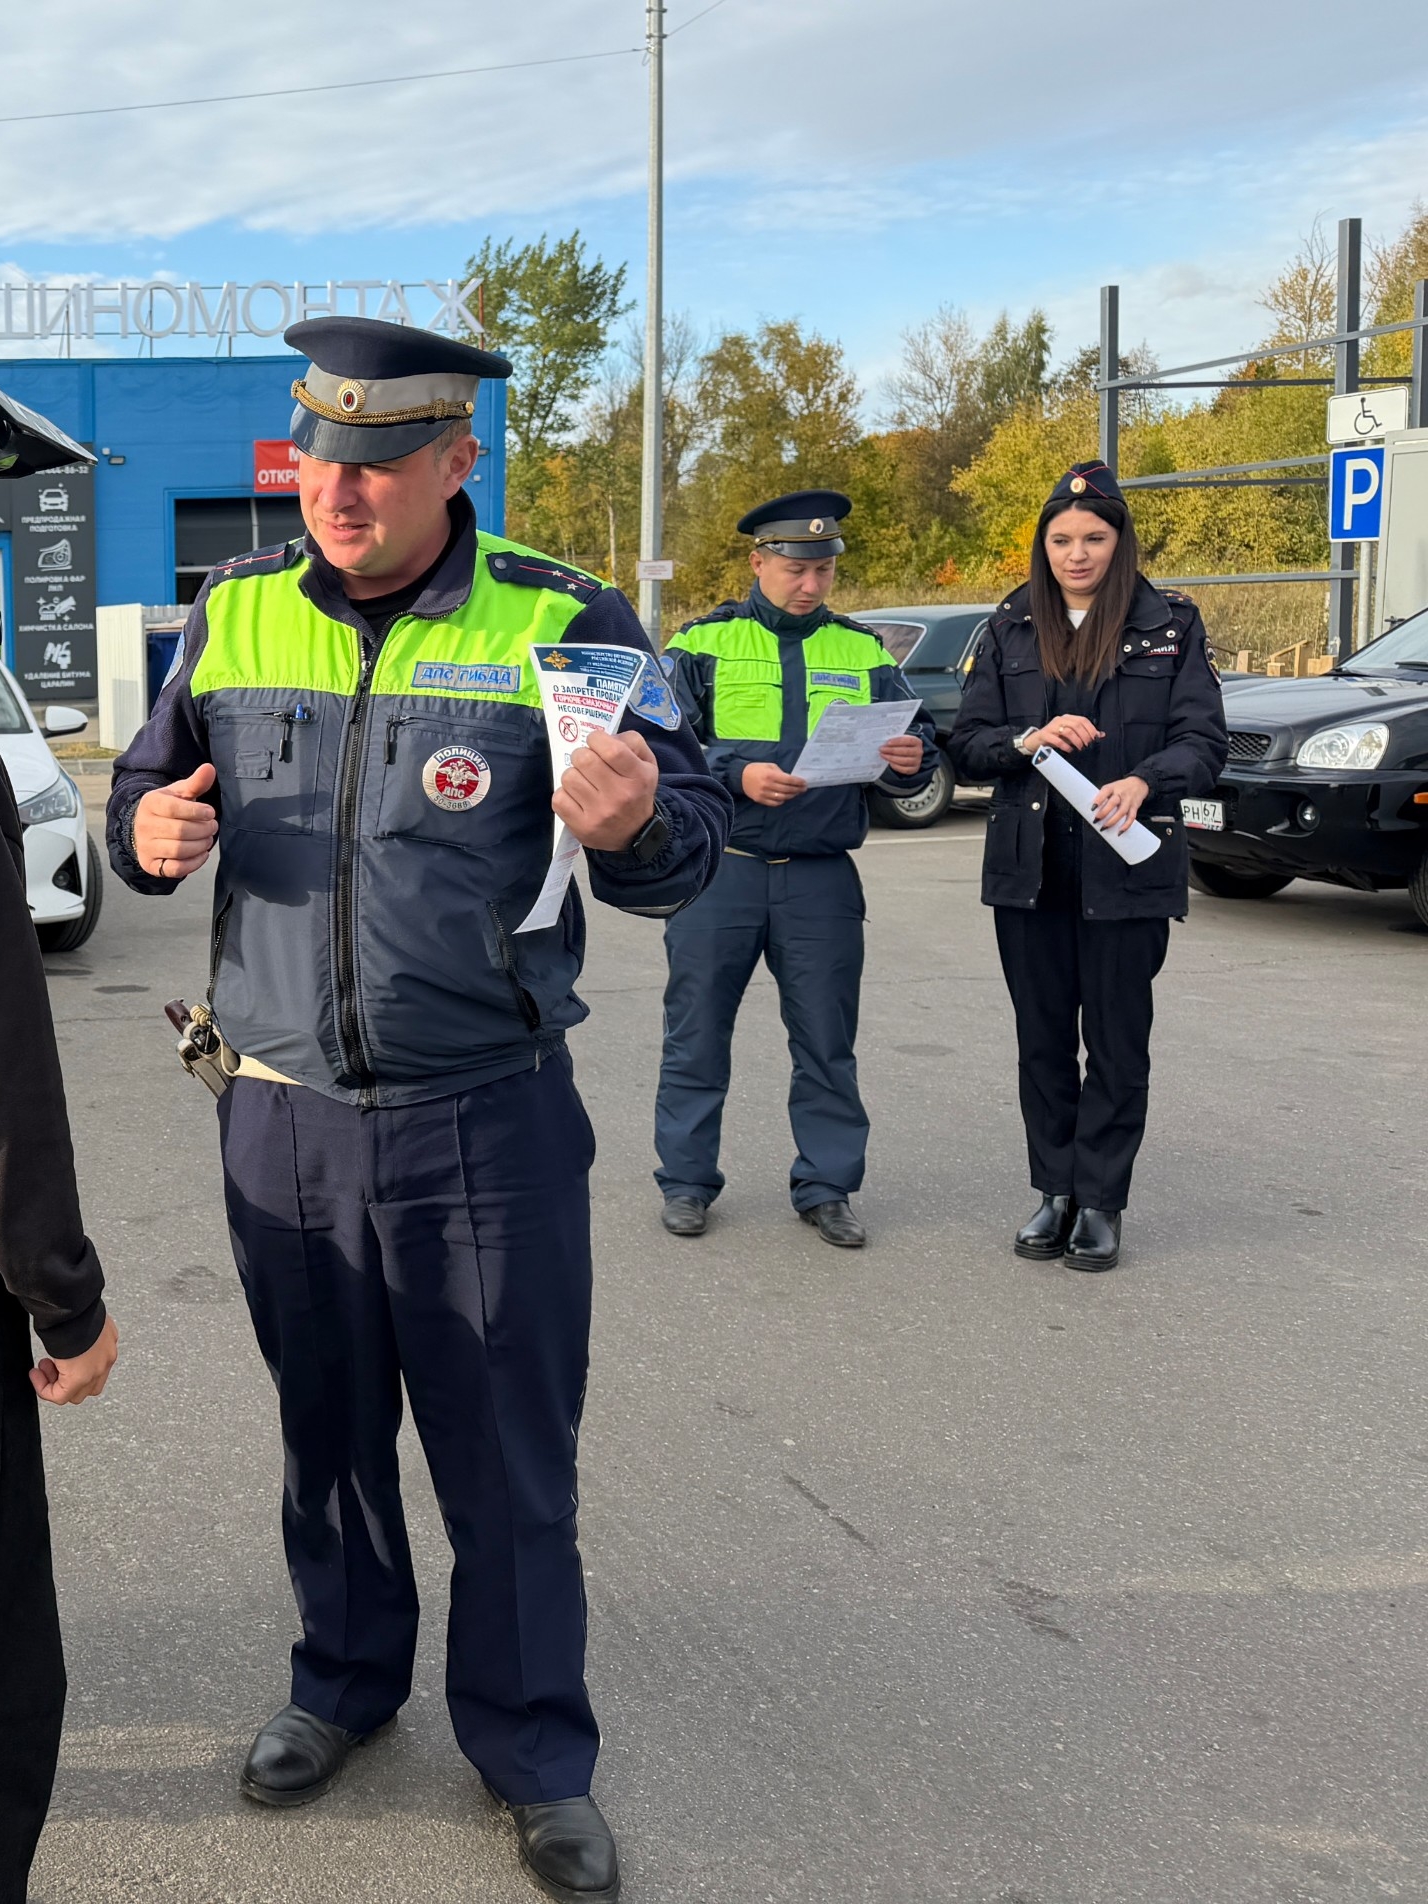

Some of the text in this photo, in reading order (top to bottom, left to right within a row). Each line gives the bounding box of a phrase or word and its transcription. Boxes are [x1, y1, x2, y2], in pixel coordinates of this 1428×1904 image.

[29, 524, 78, 532] ПОДГОТОВКА
[63, 623, 94, 631] САЛОНА
[24, 672, 61, 680] УДАЛЕНИЕ
[420, 667, 511, 685] ДПС ГИБДД
[561, 685, 594, 697] ЗАПРЕТЕ
[436, 747, 487, 771] ПОЛИЦИЯ
[442, 786, 465, 798] ДПС
